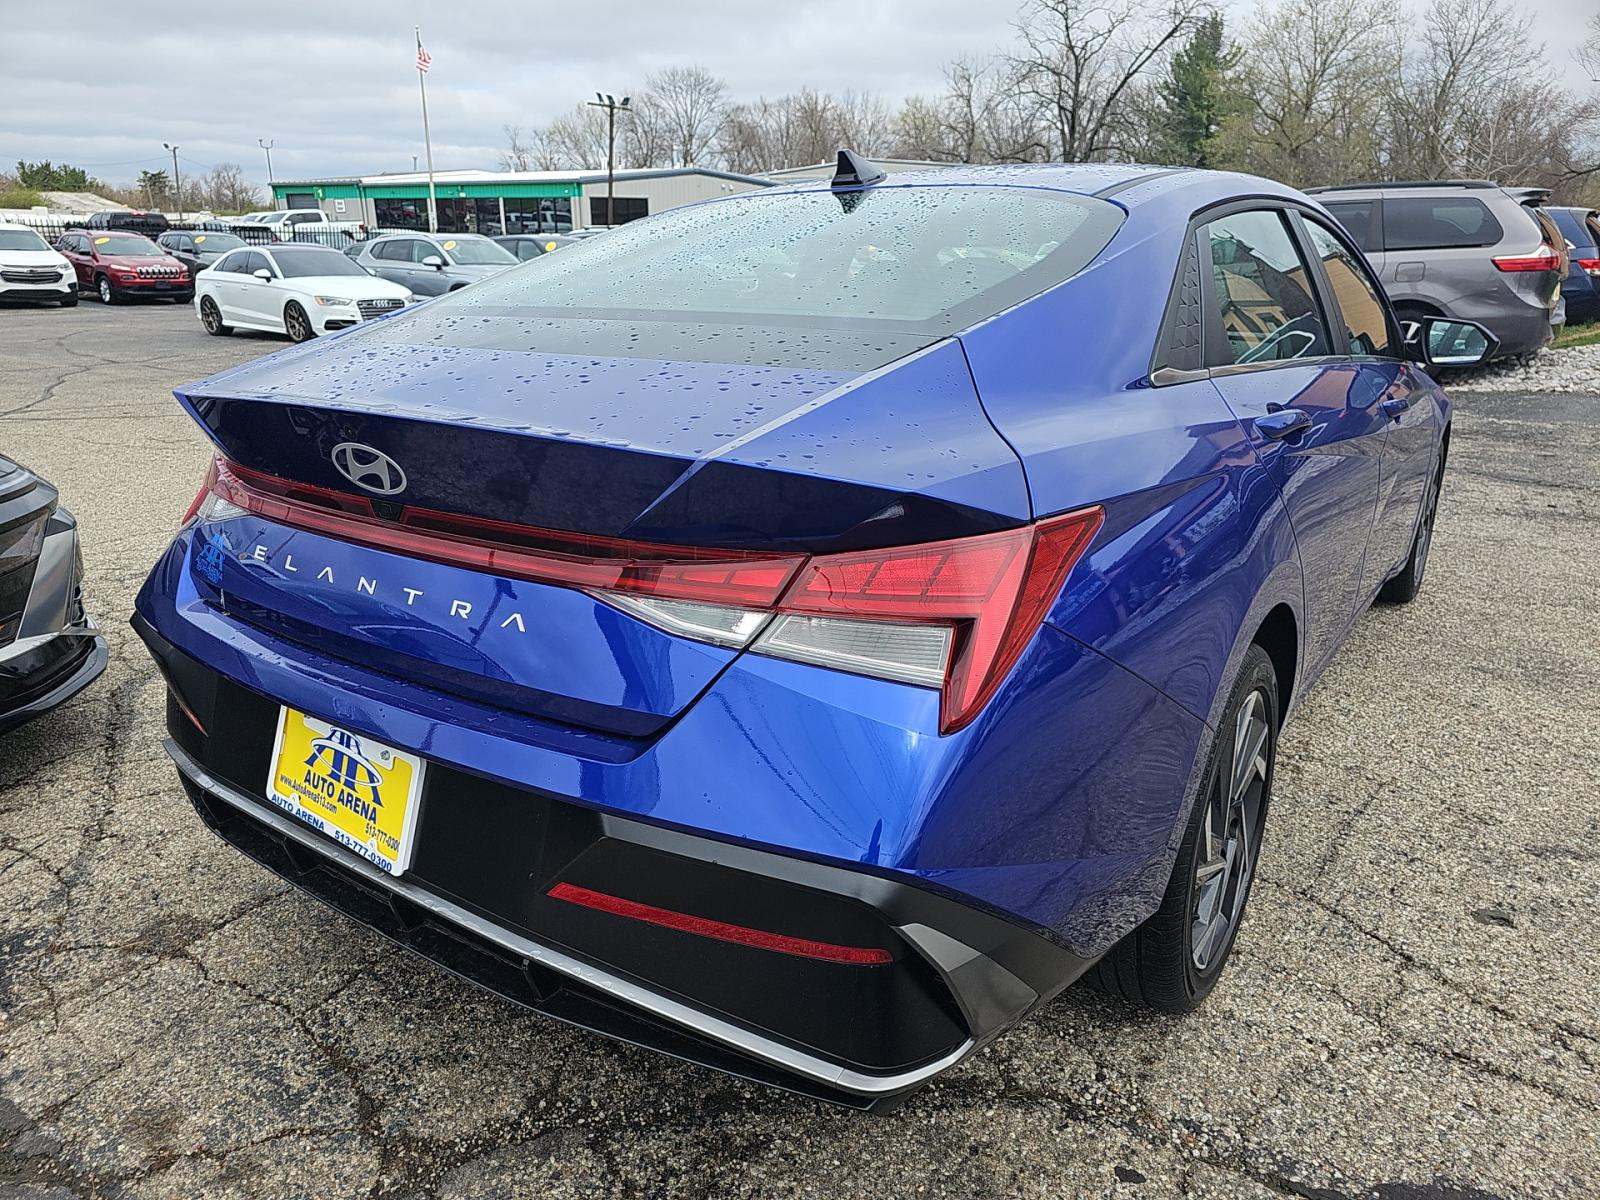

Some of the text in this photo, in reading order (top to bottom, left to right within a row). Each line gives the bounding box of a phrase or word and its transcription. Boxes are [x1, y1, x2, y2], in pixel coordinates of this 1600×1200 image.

[253, 545, 527, 633] ELANTRA
[271, 794, 393, 872] AUTO ARENA 513-777-0300
[304, 769, 377, 825] AUTO ARENA
